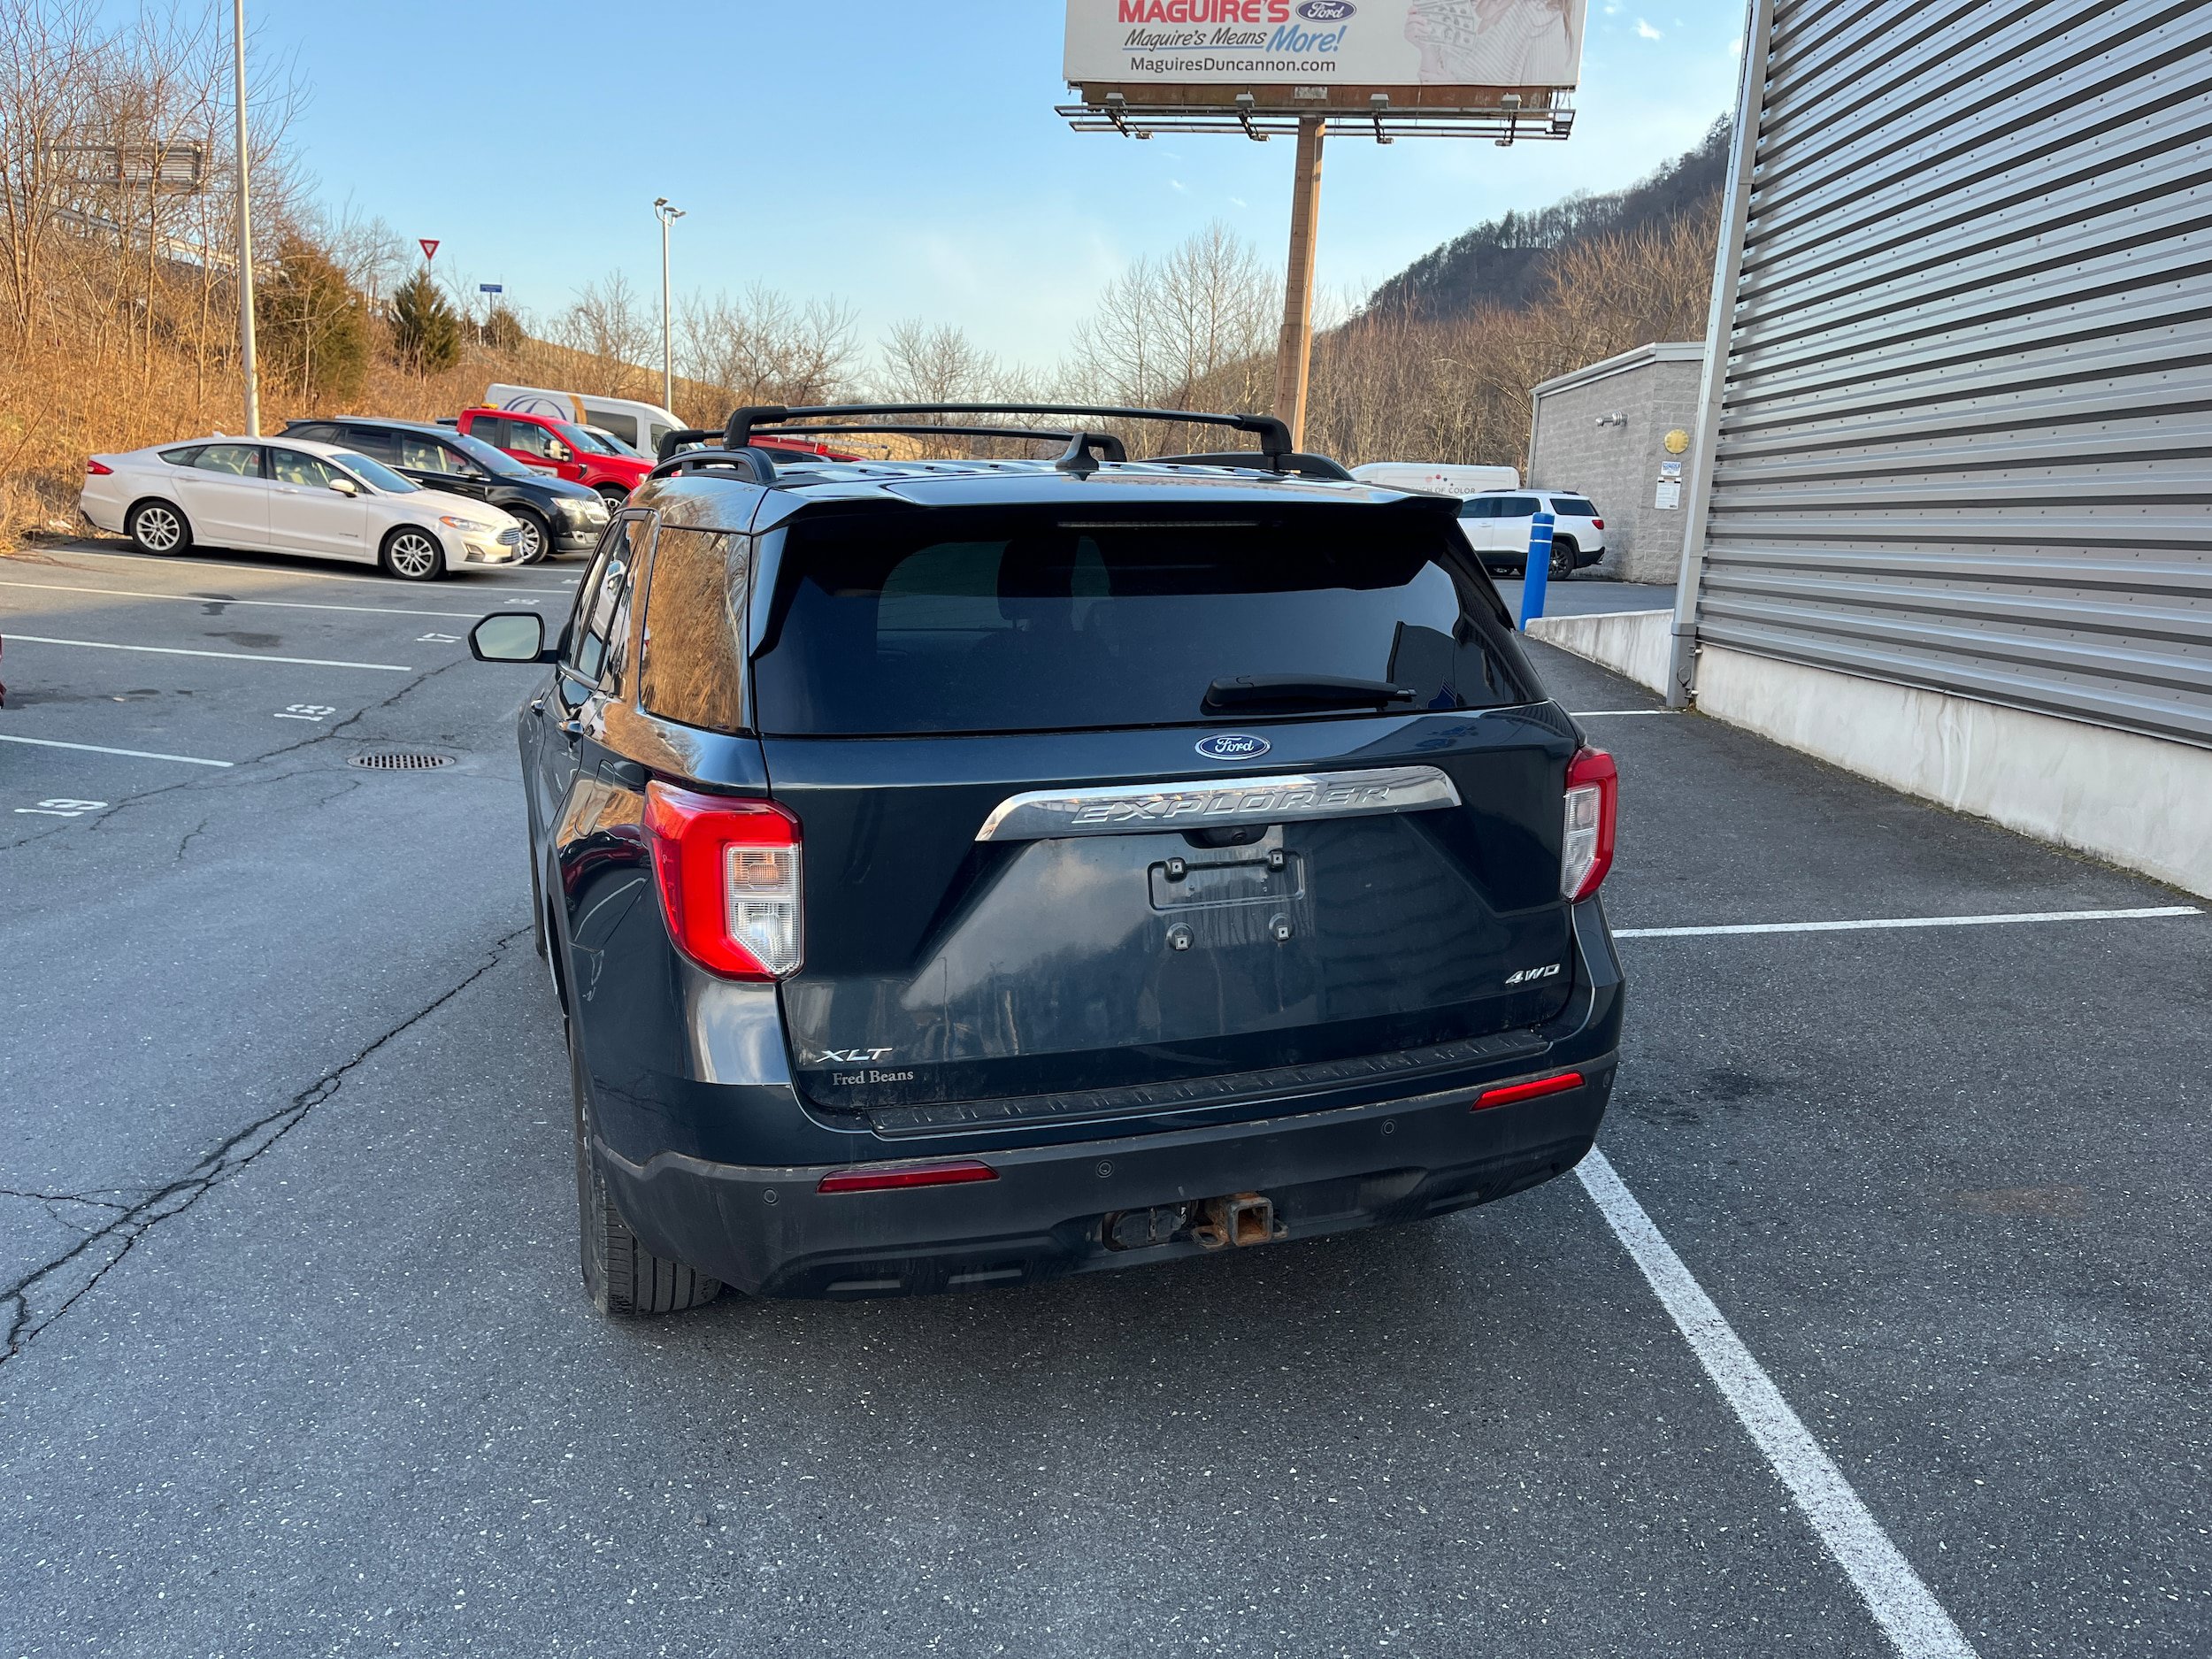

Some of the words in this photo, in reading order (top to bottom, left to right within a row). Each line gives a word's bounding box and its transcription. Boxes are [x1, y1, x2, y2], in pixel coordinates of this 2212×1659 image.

[1118, 0, 1290, 23] MAGUIRE'S
[1307, 2, 1343, 19] Ford
[1125, 27, 1207, 51] Maguire's
[1210, 27, 1267, 45] Means
[1265, 24, 1348, 53] More!
[1131, 57, 1336, 73] MaguiresDuncannon.com
[1215, 737, 1255, 753] Ford
[1071, 784, 1390, 825] EXPLORER
[1504, 964, 1561, 985] 4WD
[816, 1048, 894, 1063] XLT
[832, 1070, 866, 1086] Fred
[869, 1068, 915, 1084] Beans
